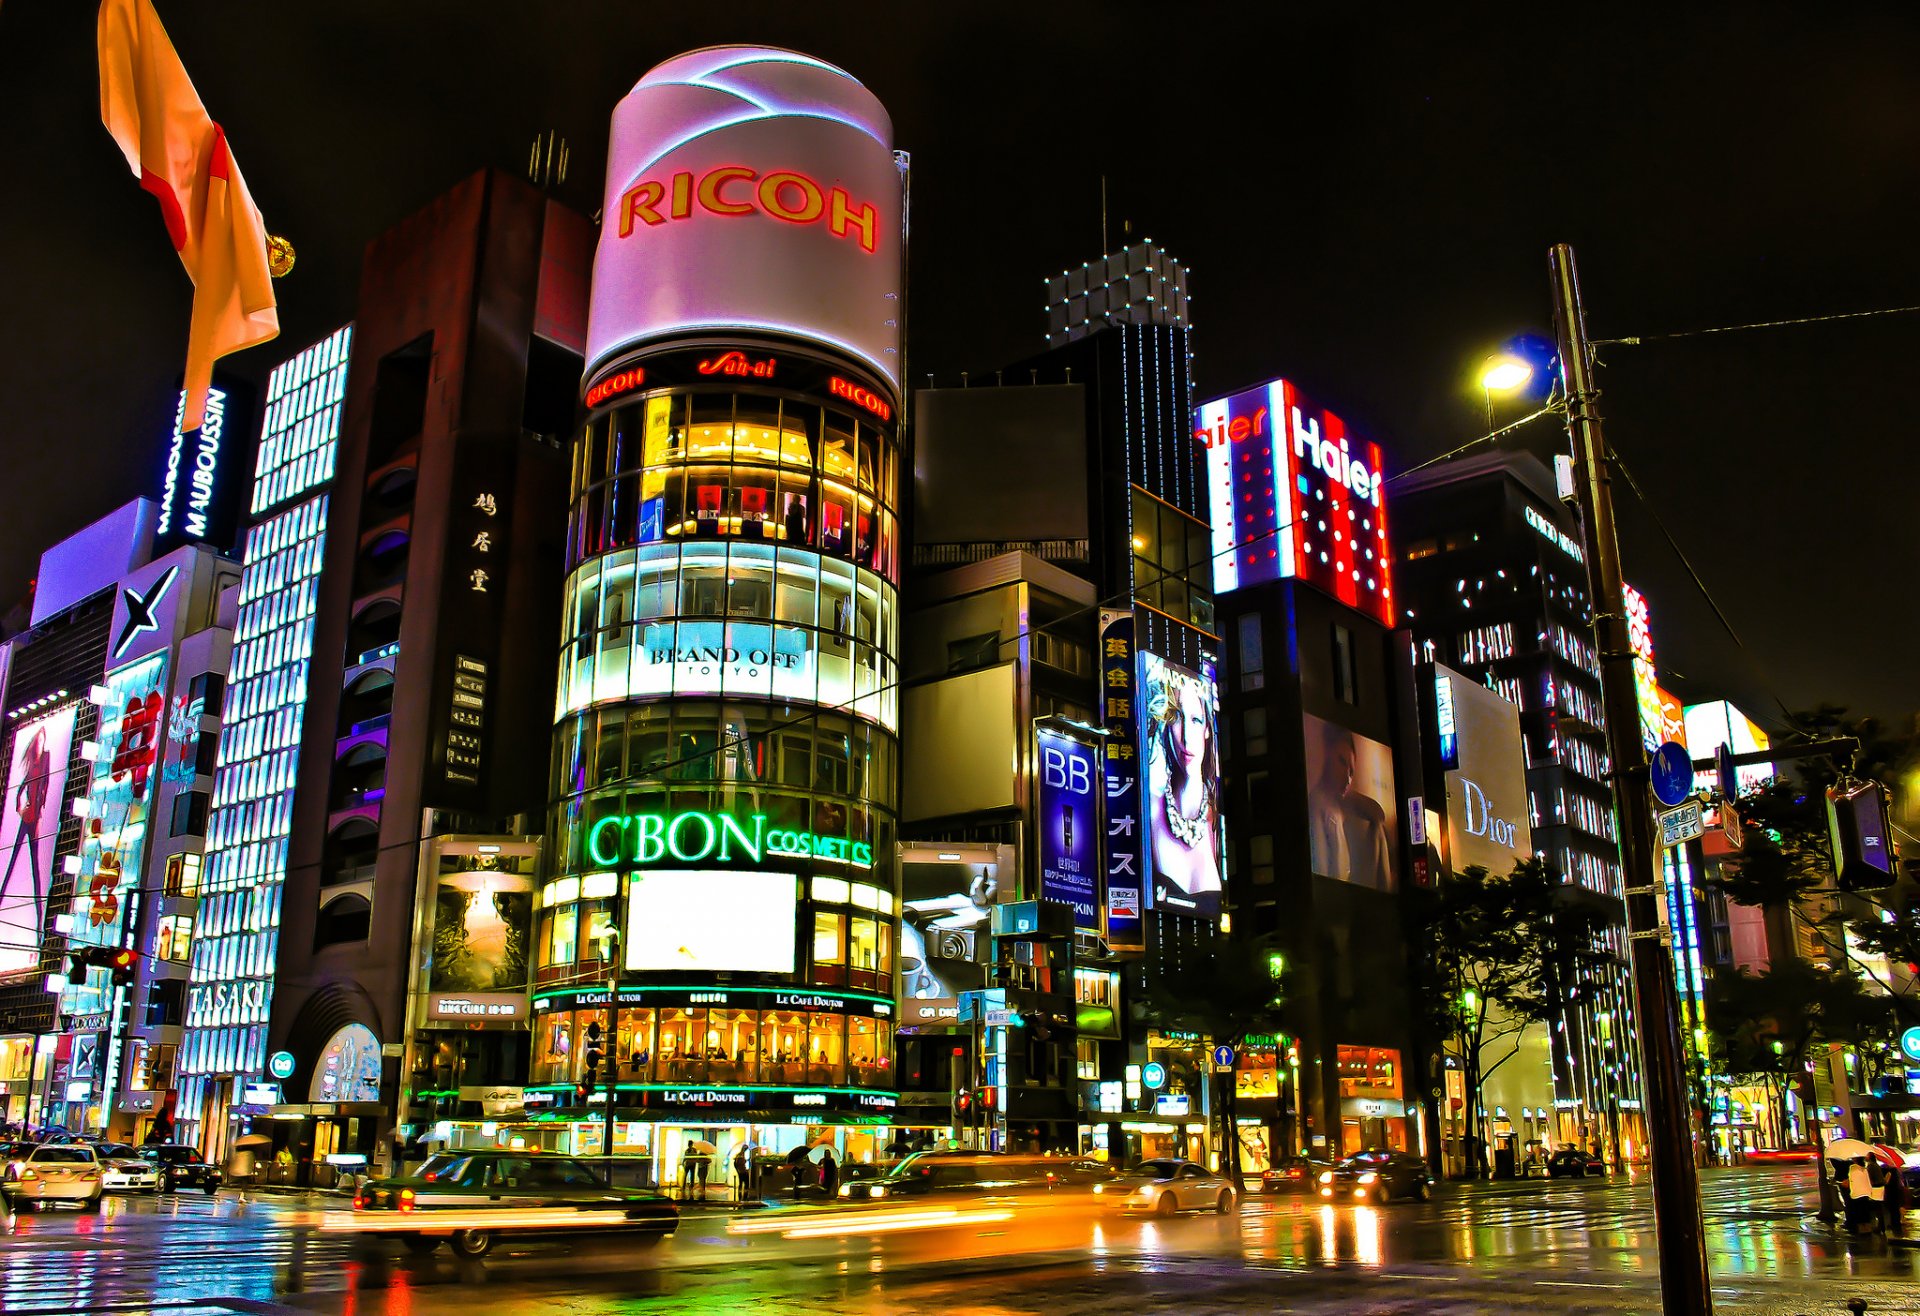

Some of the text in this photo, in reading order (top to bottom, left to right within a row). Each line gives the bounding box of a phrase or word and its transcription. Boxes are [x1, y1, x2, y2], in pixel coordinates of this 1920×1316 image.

[617, 166, 876, 254] RICOH
[585, 367, 645, 408] RICOH
[829, 376, 891, 420] RICOH
[1194, 406, 1267, 449] aier
[185, 386, 227, 537] MAUBOUSSIN
[1292, 406, 1382, 507] Haier
[650, 647, 800, 669] BRAND OFF
[688, 666, 758, 678] TOYO
[1045, 747, 1089, 796] B.B
[1107, 776, 1136, 876] ジオス
[1461, 777, 1517, 849] Dior
[589, 811, 873, 867] C'BON COSMETCS
[189, 981, 266, 1013] TASAKI
[776, 994, 789, 1004] LE
[664, 1091, 677, 1102] LE
[706, 1091, 746, 1103] DOUTOR
